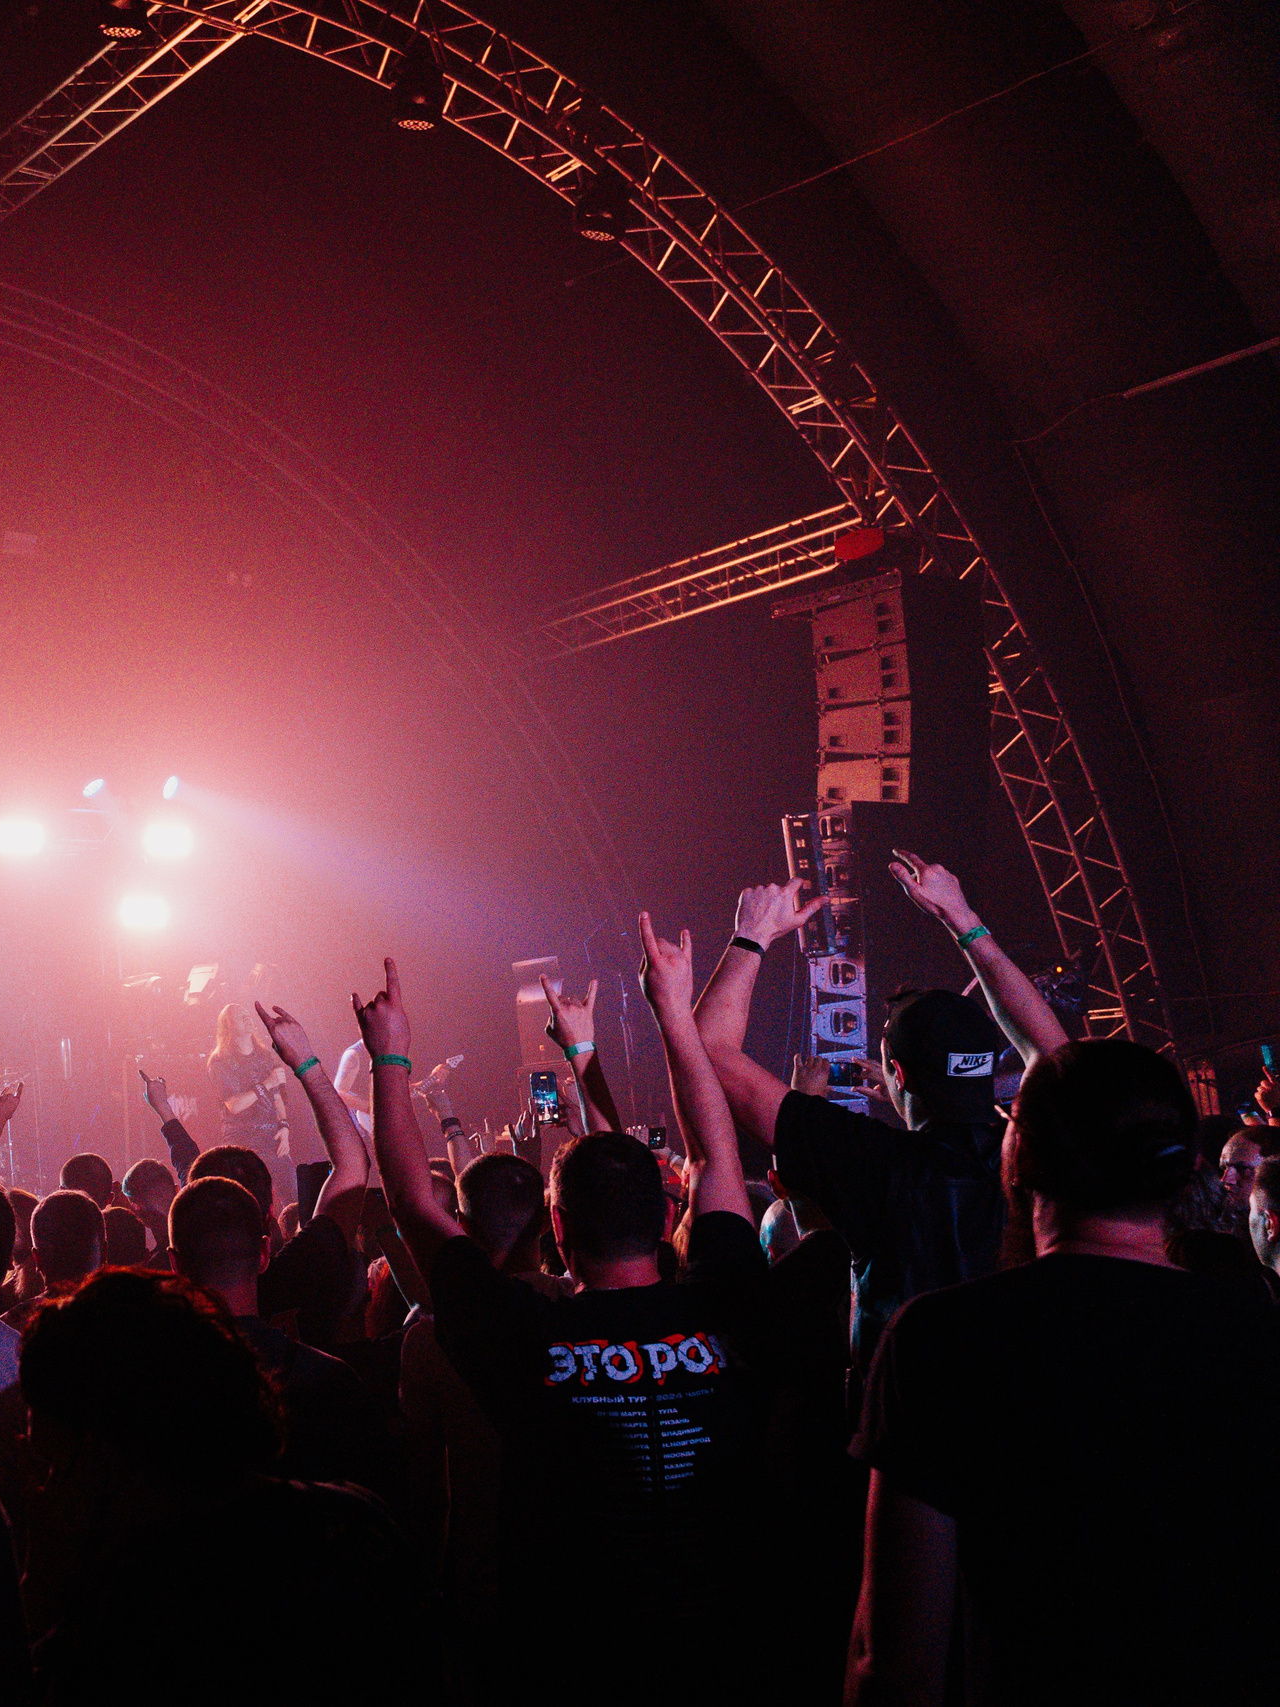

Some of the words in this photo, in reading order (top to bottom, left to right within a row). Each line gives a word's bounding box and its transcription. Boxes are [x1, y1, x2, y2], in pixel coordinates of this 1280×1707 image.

[960, 1055, 987, 1066] NIKE
[546, 1341, 640, 1384] ЭТО
[571, 1394, 625, 1404] КЛУБНЫЙ
[627, 1395, 648, 1404] ТУР
[656, 1392, 683, 1402] 2024
[657, 1407, 679, 1415] ТУЛА
[659, 1418, 690, 1426] РЯЗАНЬ
[660, 1426, 704, 1437] ВЛАДИМИР
[663, 1450, 696, 1459] МОСКВА
[664, 1461, 694, 1470] КАЗАНЬ
